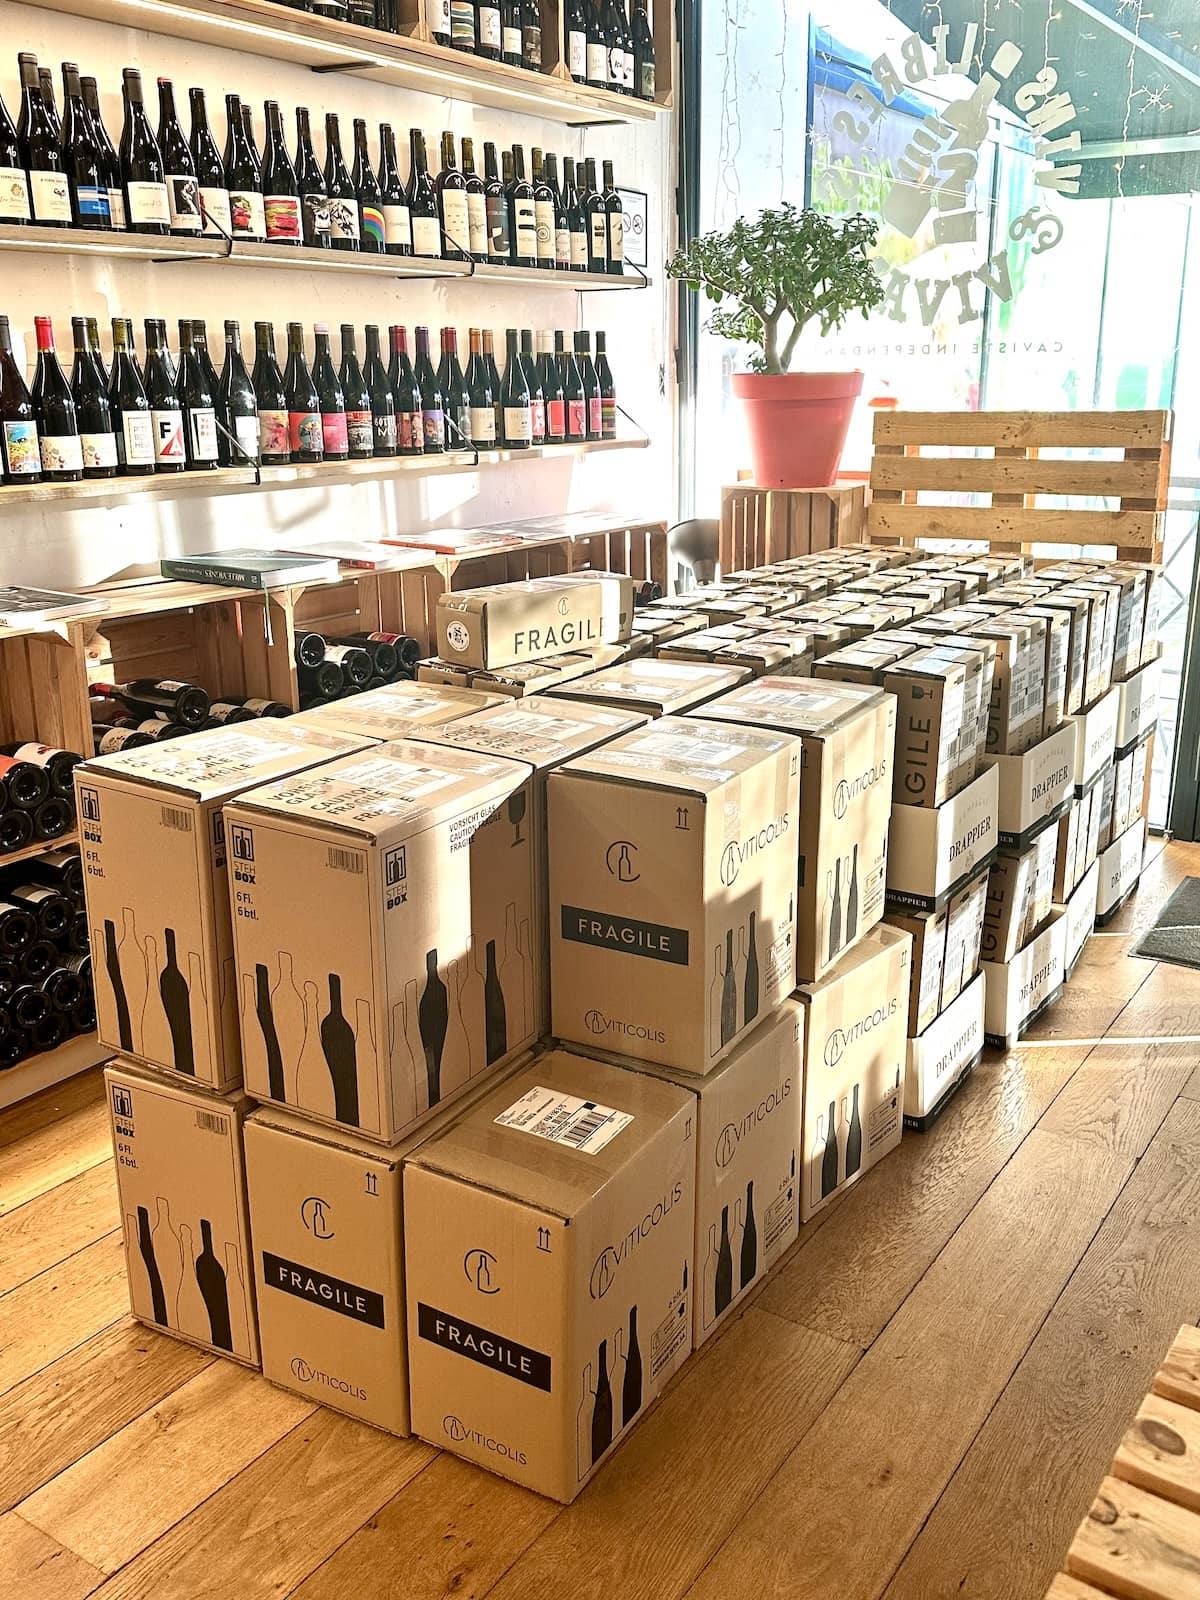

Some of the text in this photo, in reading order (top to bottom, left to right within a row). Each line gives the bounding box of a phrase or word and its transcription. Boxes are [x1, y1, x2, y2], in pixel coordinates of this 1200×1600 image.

[1032, 765, 1068, 803] DRAPPIER
[84, 831, 103, 844] BOX
[449, 812, 479, 832] VORSICHT
[450, 823, 477, 843] CAUTION
[738, 812, 790, 864] VITICOLIS
[949, 815, 991, 862] DRAPPIER
[233, 860, 256, 874] STEH
[235, 870, 256, 885] BOX
[386, 884, 408, 899] STEH
[387, 894, 408, 910] BOX
[577, 918, 671, 953] FRAGILE
[604, 1018, 666, 1044] VITICOLIS
[842, 998, 897, 1048] VITICOLIS
[734, 1077, 792, 1138] VITICOLIS
[116, 1126, 136, 1138] BOX
[611, 1181, 682, 1267] VITICOLIS
[279, 1267, 367, 1313] FRAGILE
[435, 1320, 533, 1376] FRAGILE
[309, 1368, 368, 1401] VITICOLIS
[462, 1430, 528, 1466] VITICOLIS
